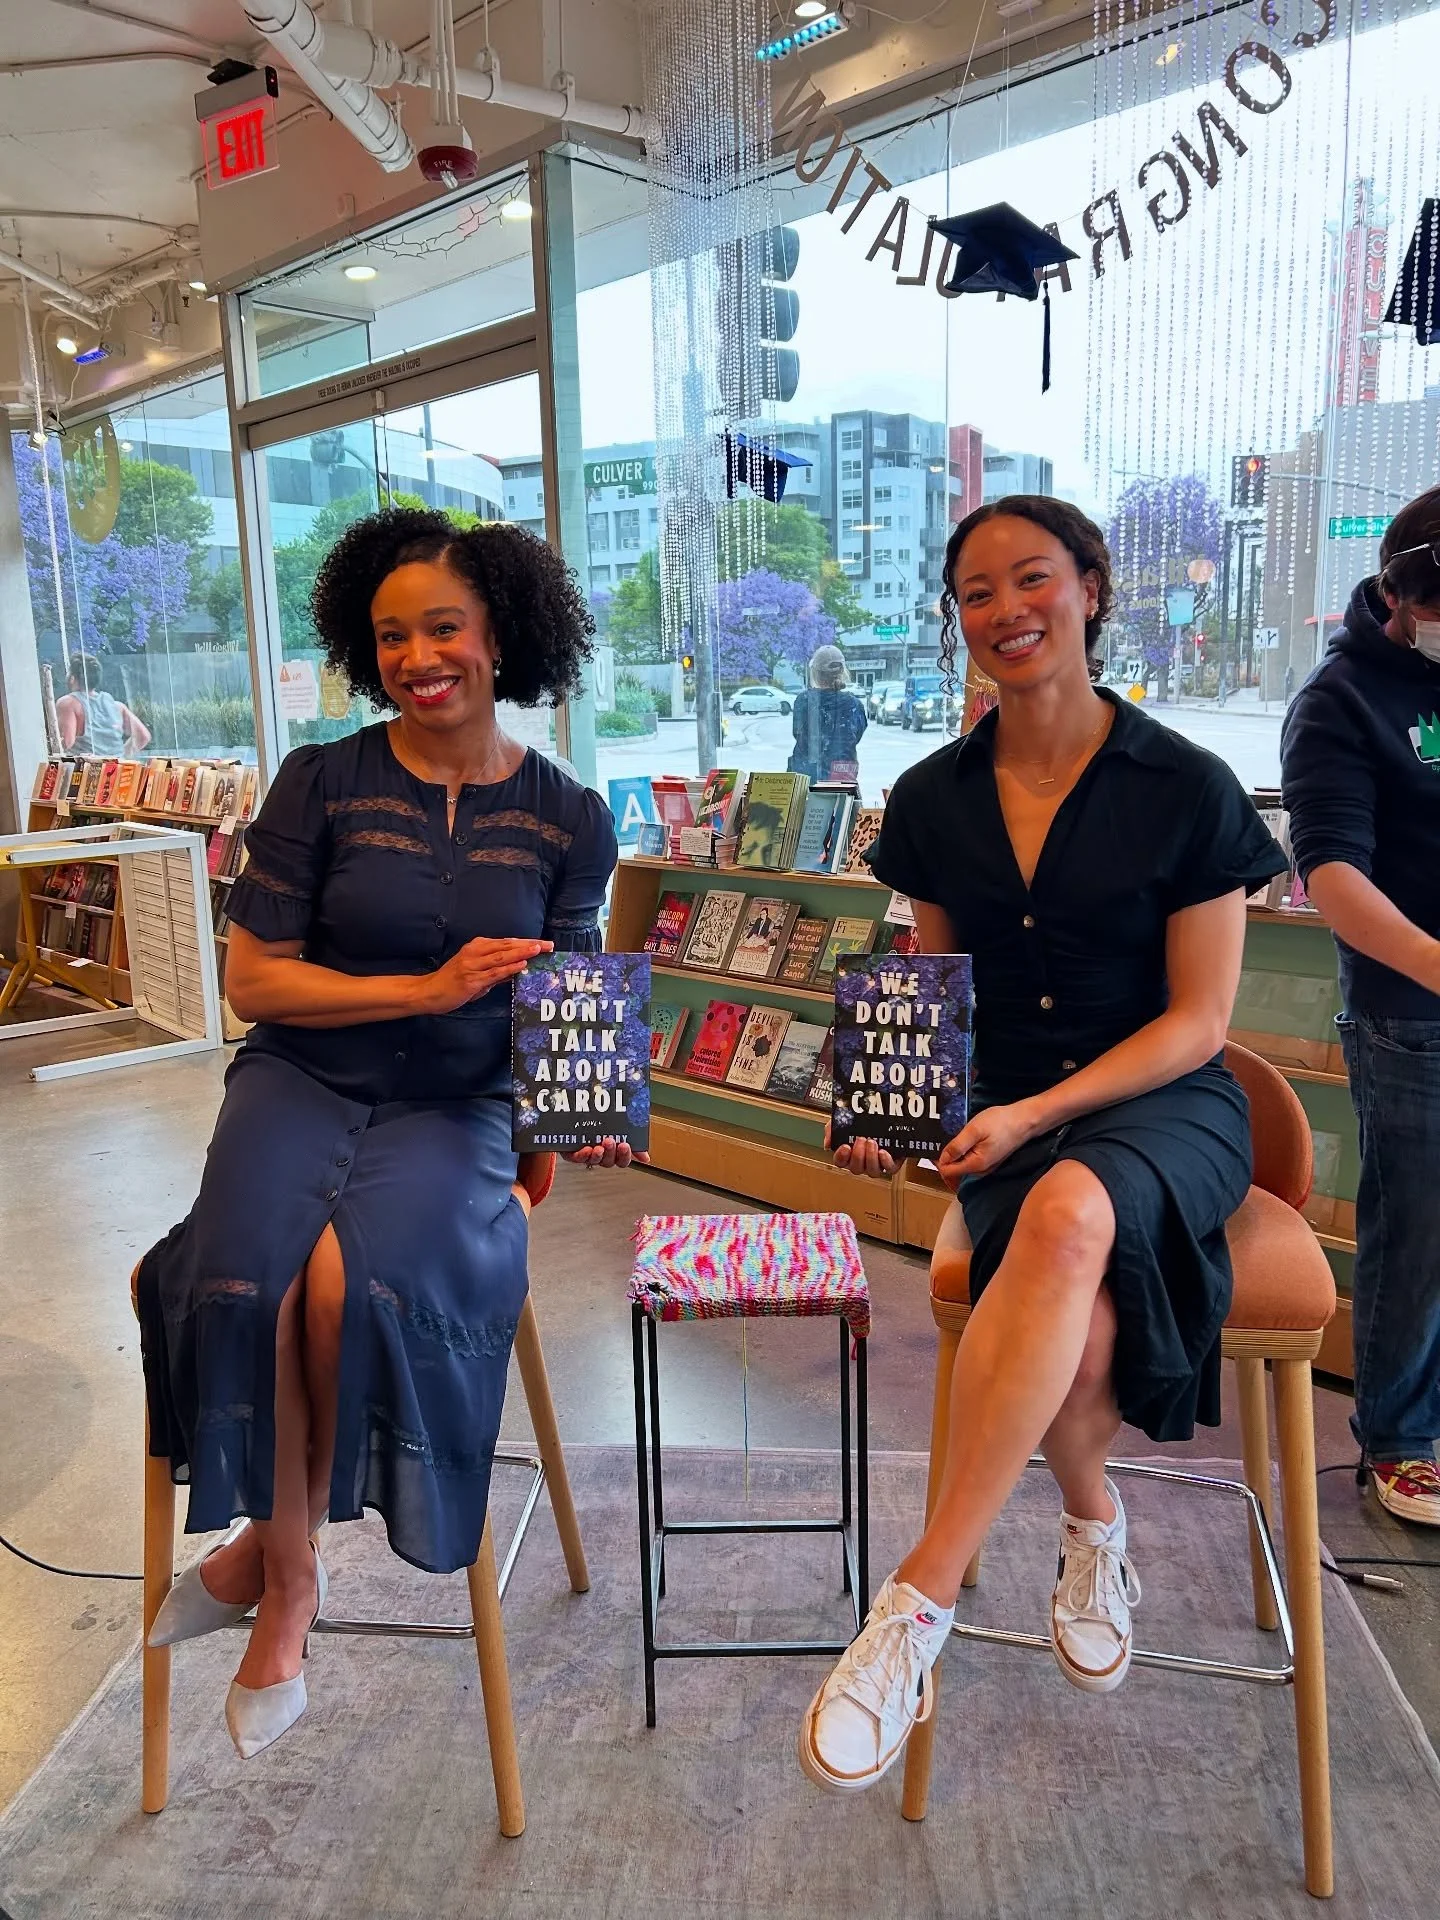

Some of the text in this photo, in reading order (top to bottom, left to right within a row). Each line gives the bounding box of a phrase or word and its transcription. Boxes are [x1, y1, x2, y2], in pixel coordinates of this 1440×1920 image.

[216, 108, 266, 178] EXIT
[433, 160, 453, 168] FIRE
[593, 461, 643, 484] CULVER
[1335, 521, 1367, 534] ulver
[657, 909, 685, 920] UNICORN
[656, 919, 680, 930] WOMAN
[801, 923, 823, 933] Heard
[792, 932, 821, 943] Her Call
[643, 941, 678, 955] GAYL JONES
[786, 942, 820, 953] My Name
[788, 959, 806, 969] Lucy
[565, 969, 603, 993] WE
[783, 969, 805, 979] Sante
[880, 971, 919, 996] WE
[540, 998, 626, 1022] DON'T
[856, 1000, 942, 1027] DON'T
[750, 1011, 776, 1026] DEVIL
[548, 1028, 617, 1052] TALK
[742, 1033, 754, 1046] IS
[863, 1030, 932, 1058] TALK
[700, 1047, 722, 1058] colored
[693, 1054, 721, 1067] television
[733, 1056, 754, 1071] FINE
[535, 1058, 629, 1082] ABOUT
[850, 1060, 944, 1089] ABOUT
[536, 1088, 627, 1113] CAROL
[851, 1090, 941, 1120] CAROL
[533, 1134, 577, 1144] KRISTEN
[582, 1134, 591, 1144] L.
[848, 1135, 942, 1151] KTEN L. BERRY
[923, 1611, 938, 1623] NIKE
